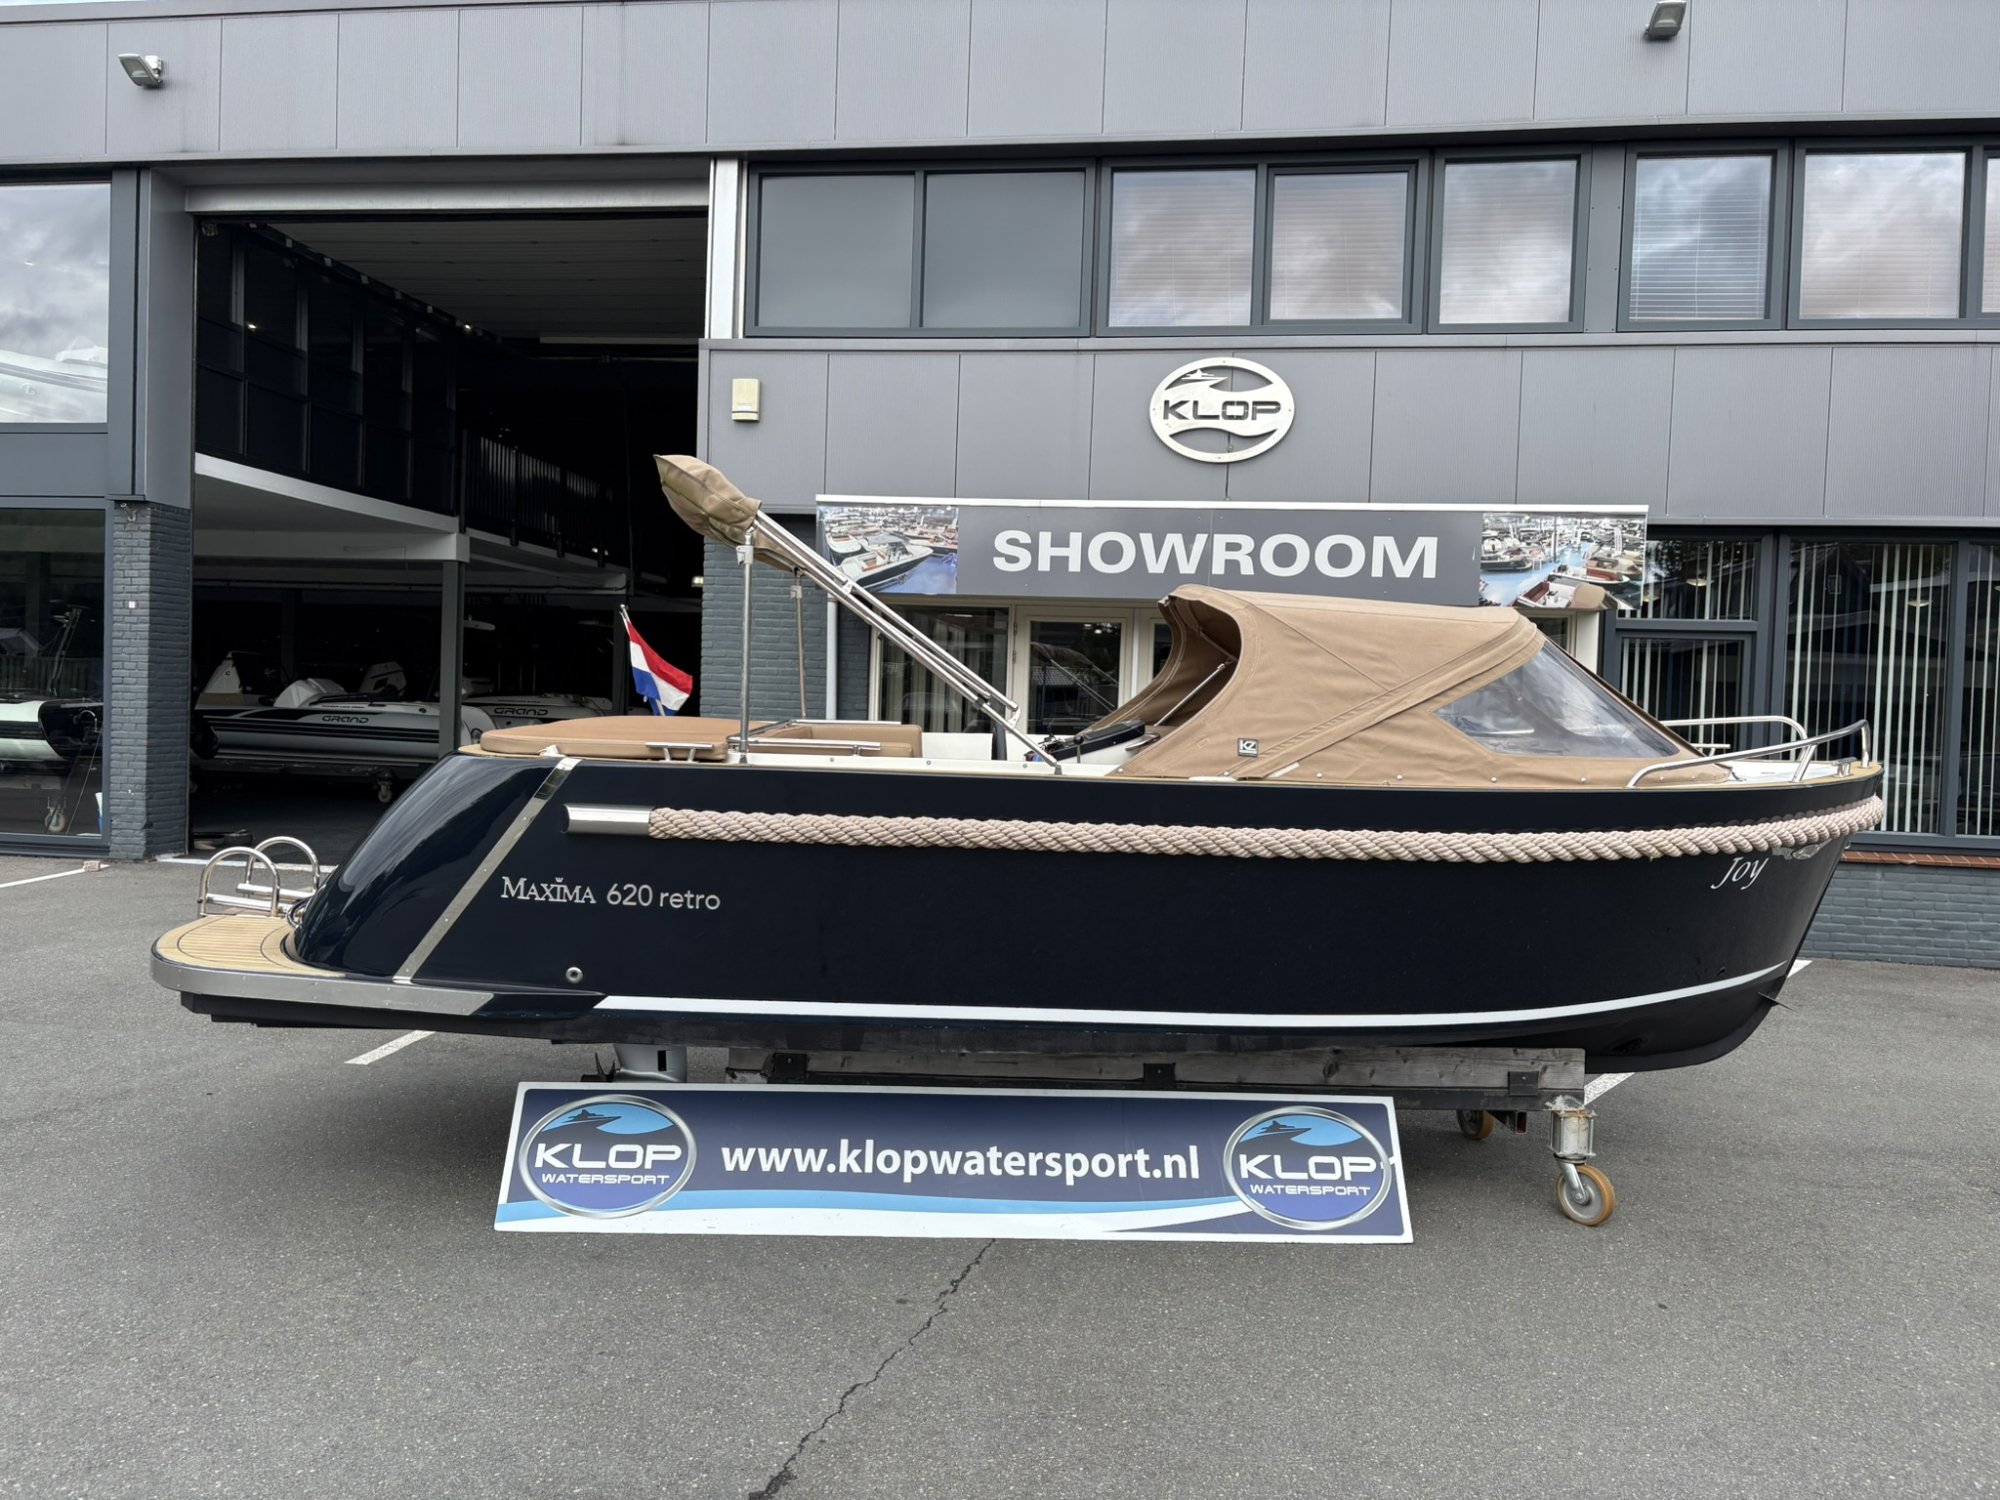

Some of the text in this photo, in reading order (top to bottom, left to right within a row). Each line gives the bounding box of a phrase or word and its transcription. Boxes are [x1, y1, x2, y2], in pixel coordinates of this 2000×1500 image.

[1163, 399, 1282, 421] KLOP
[992, 529, 1439, 579] SHOWROOM
[1710, 856, 1769, 890] Joy
[606, 883, 653, 907] 620
[659, 890, 721, 910] retro
[535, 1143, 682, 1169] KLOP
[721, 1138, 1200, 1186] www.klopwatersport.nl
[1239, 1154, 1377, 1181] KLOP
[541, 1173, 670, 1185] WATERSPORT
[1250, 1184, 1371, 1196] WATERSPORT
